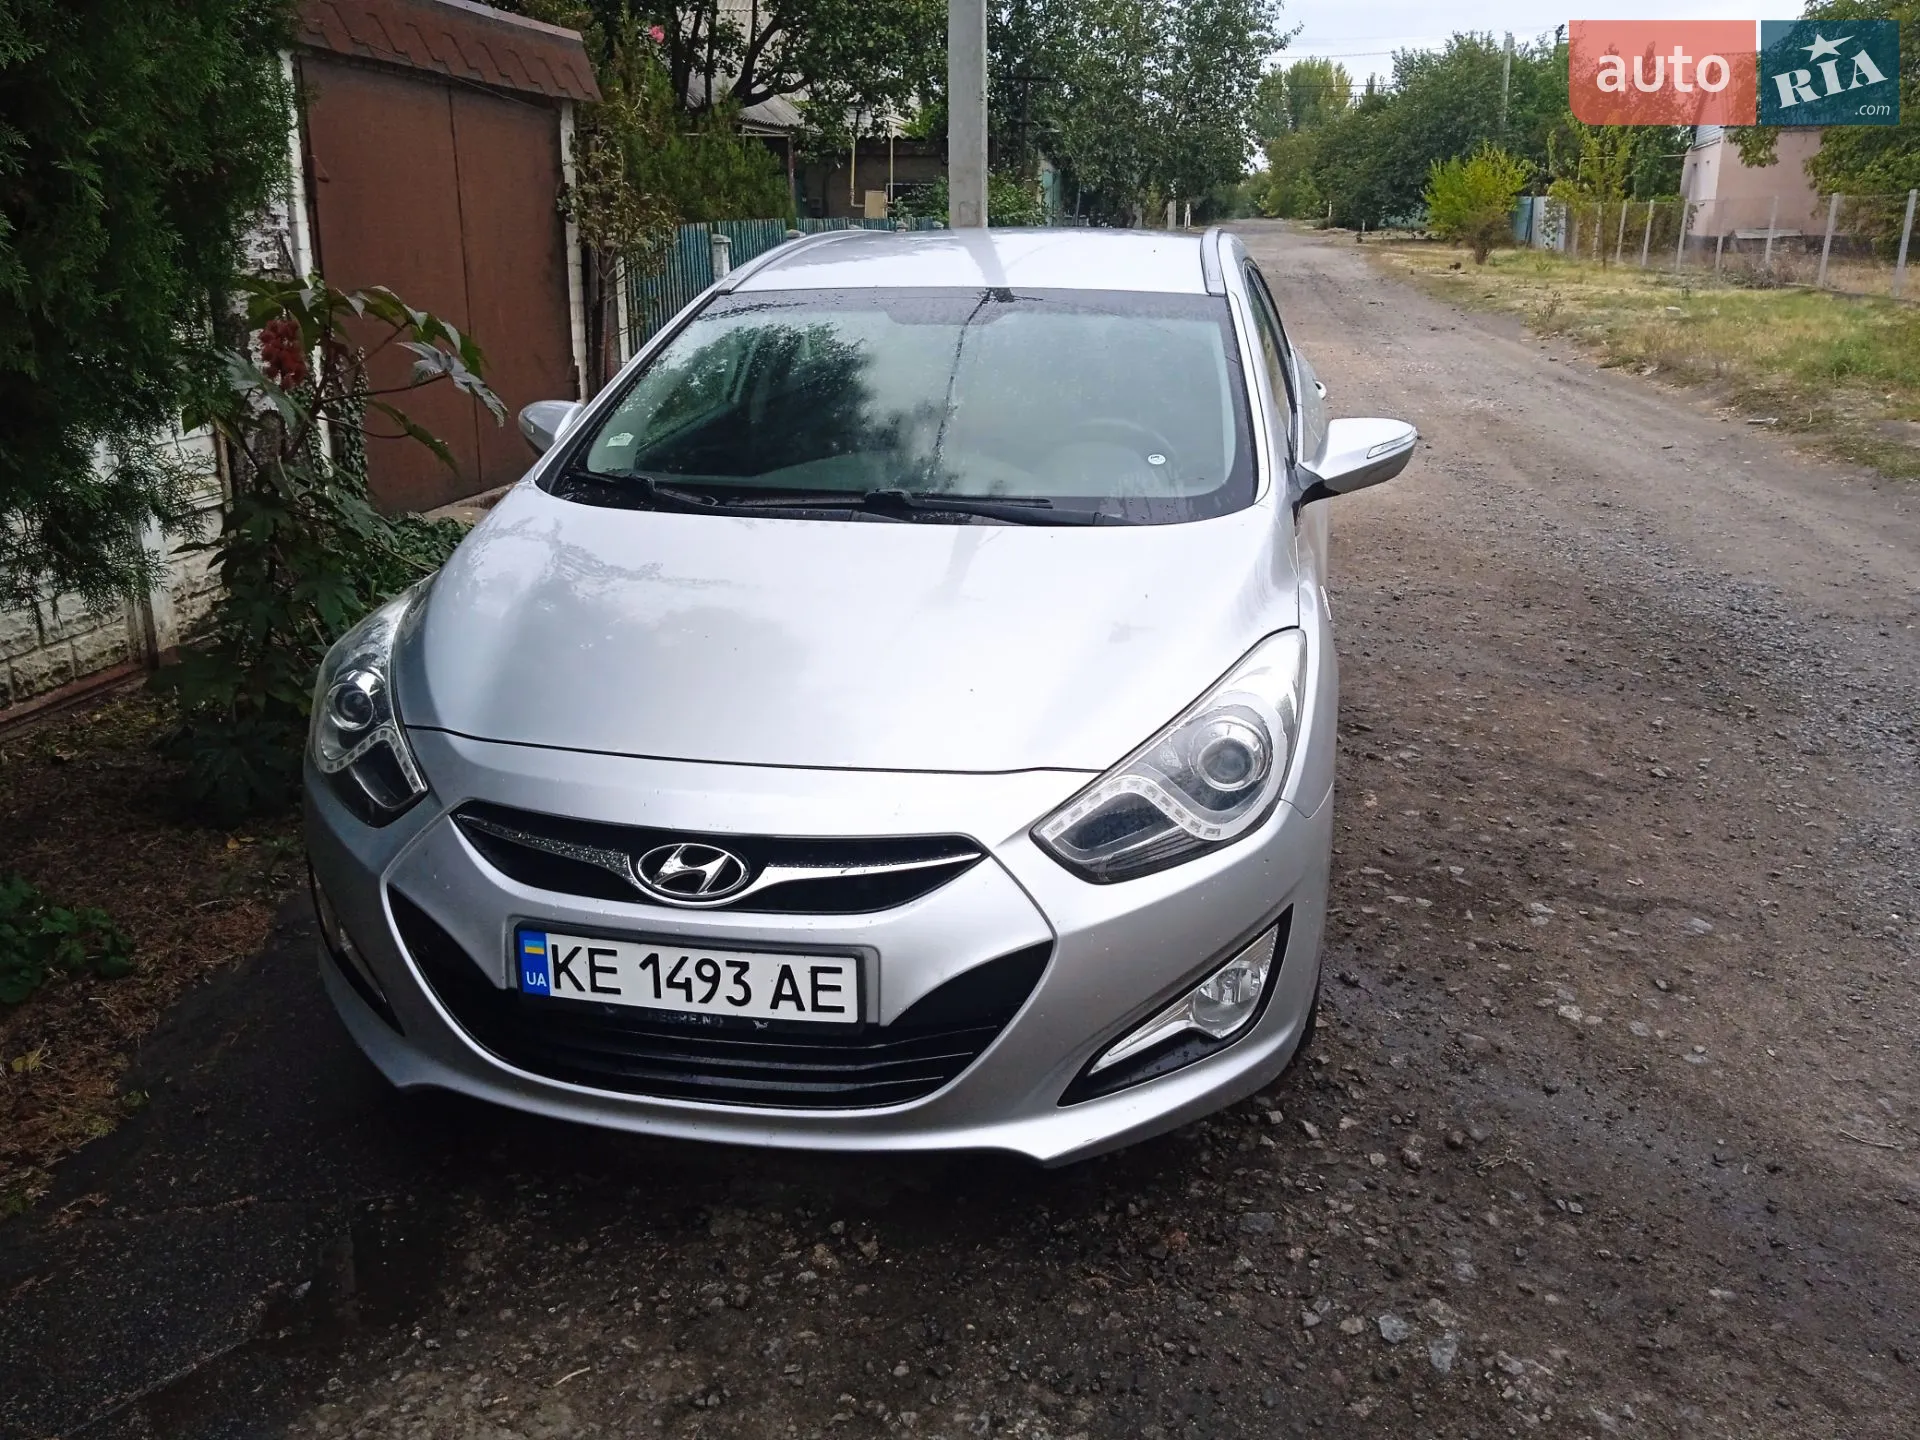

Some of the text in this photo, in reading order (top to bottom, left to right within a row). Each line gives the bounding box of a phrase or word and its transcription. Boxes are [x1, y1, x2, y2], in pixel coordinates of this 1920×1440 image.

[525, 971, 547, 988] UA
[550, 943, 845, 1014] KE 1493 AE
